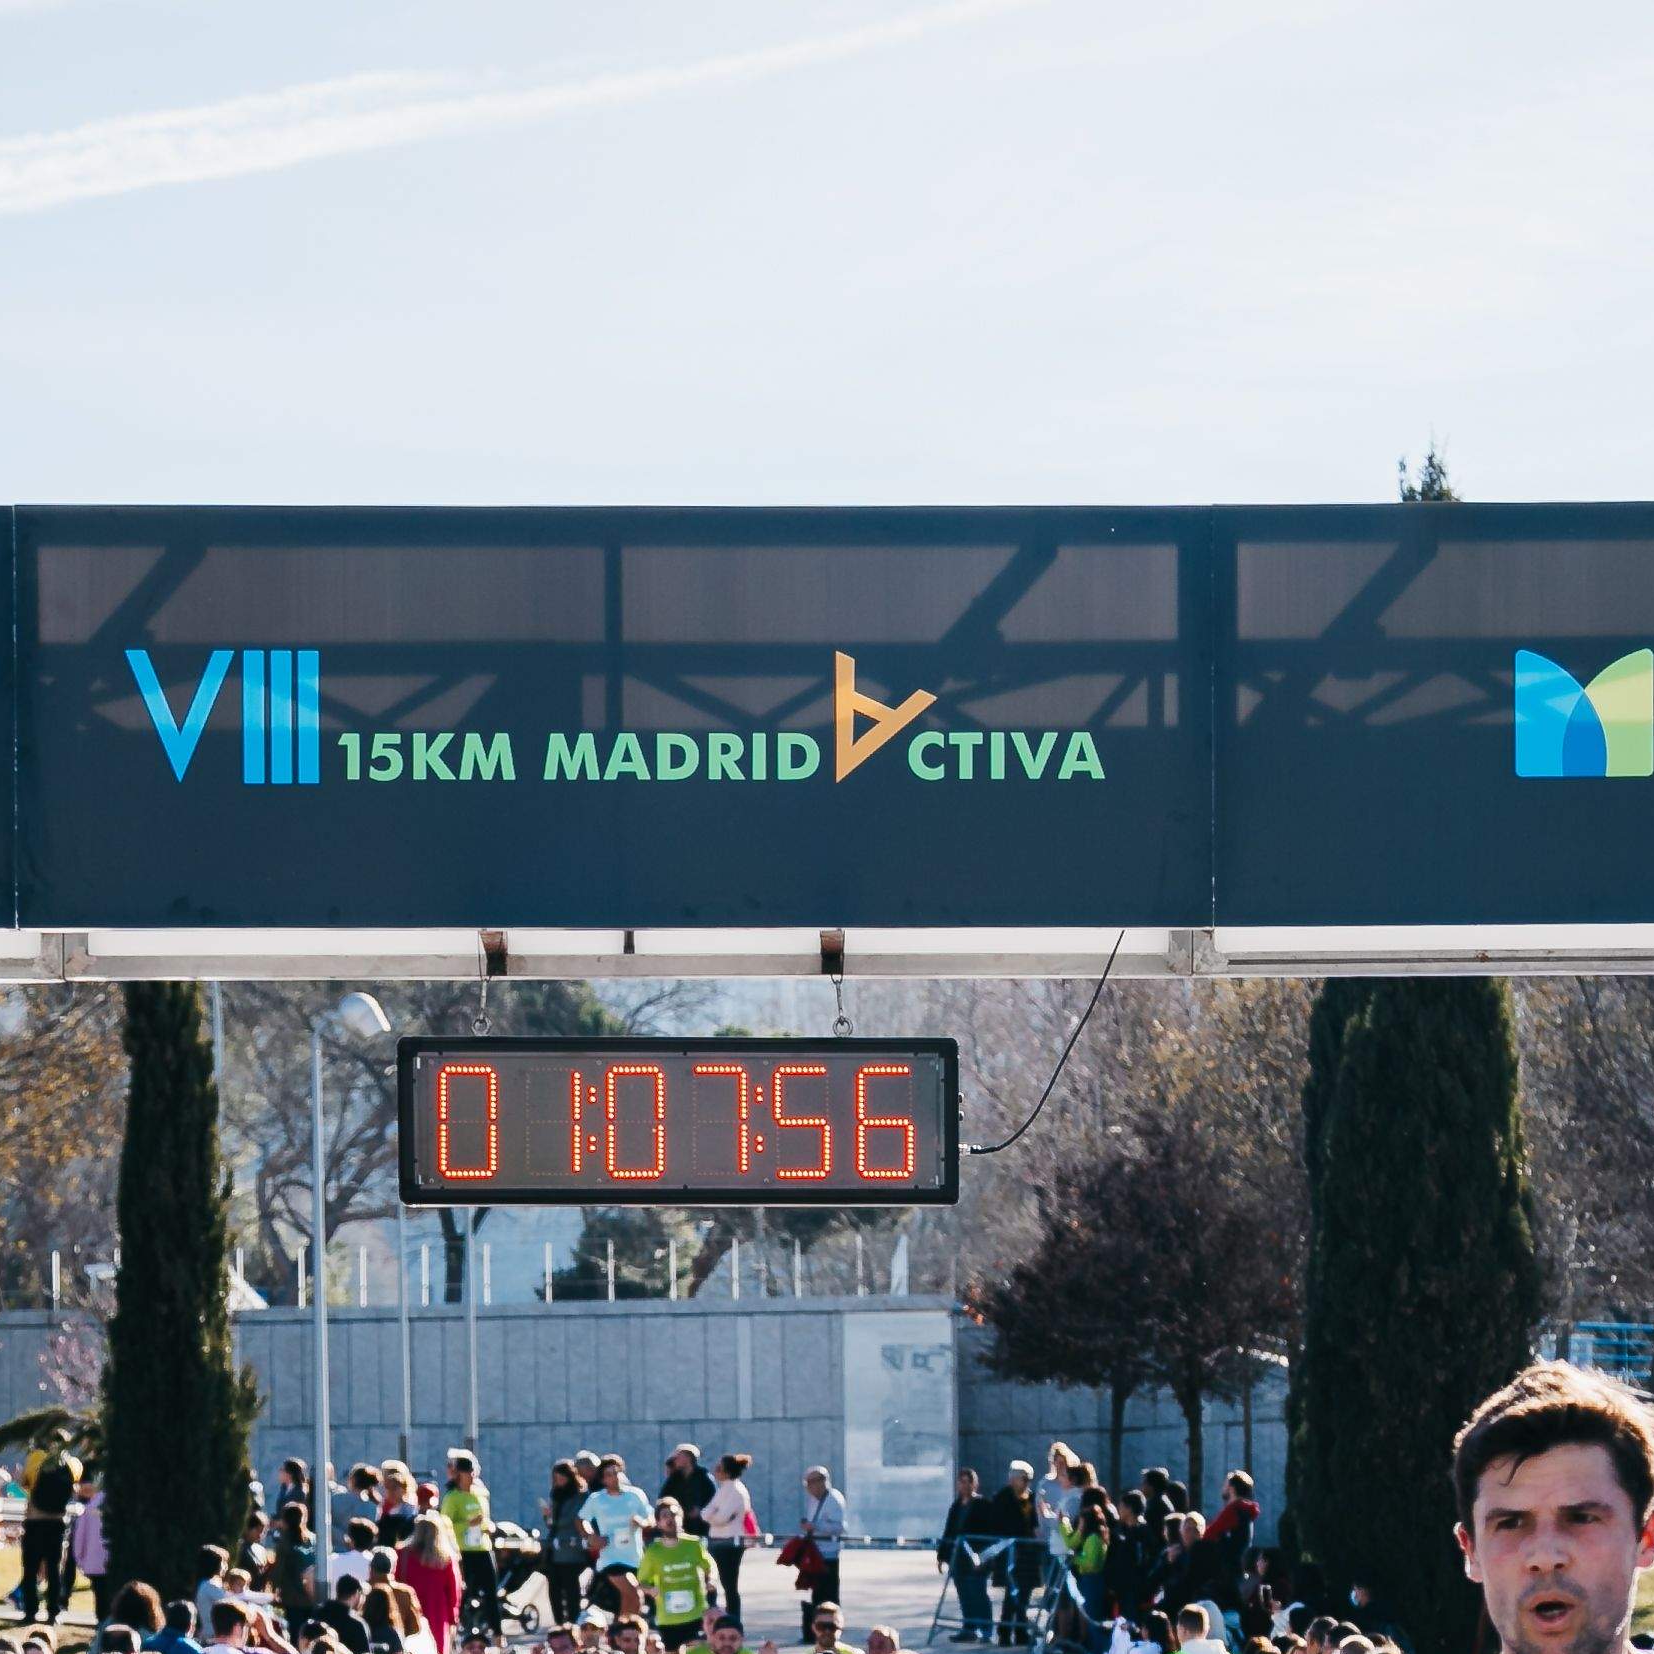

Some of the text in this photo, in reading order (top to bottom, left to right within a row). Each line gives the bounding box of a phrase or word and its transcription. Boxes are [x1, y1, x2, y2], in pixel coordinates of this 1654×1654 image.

[124, 650, 319, 784] VIII
[338, 731, 517, 782] 15KM
[542, 731, 821, 782] MADRID
